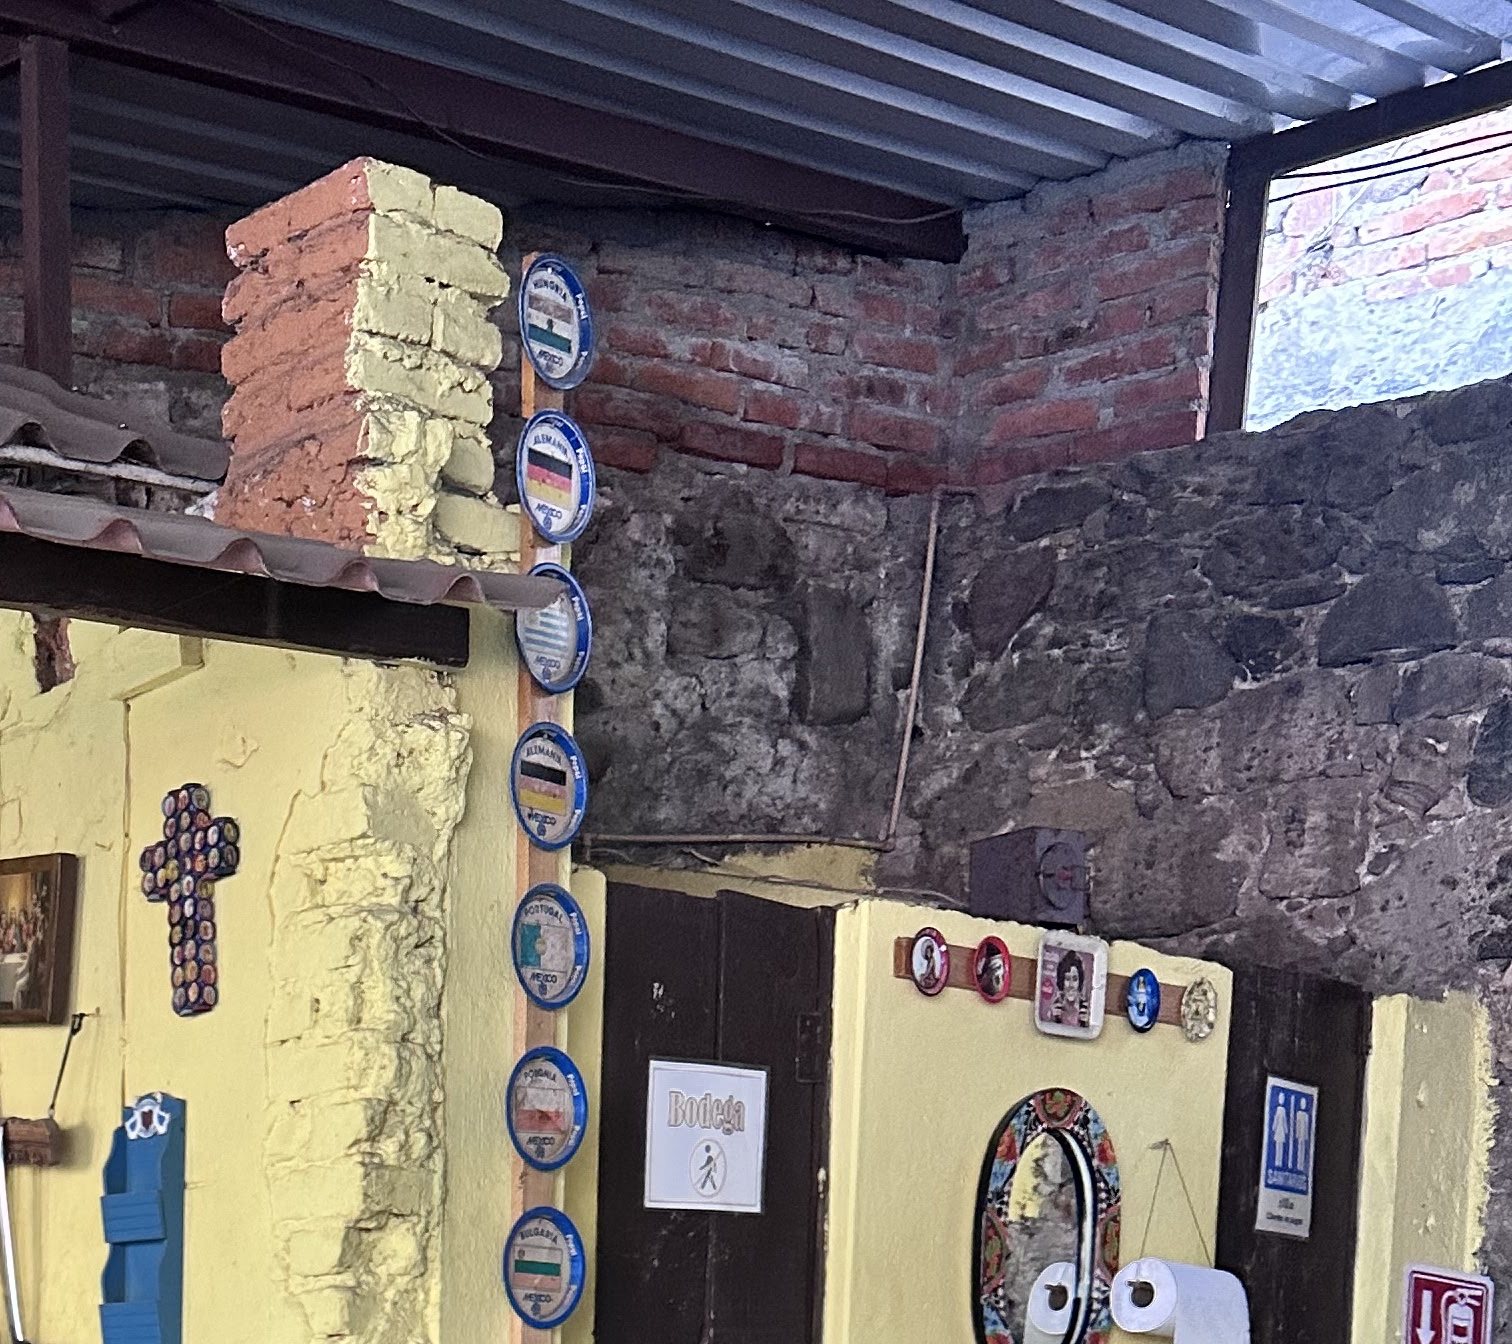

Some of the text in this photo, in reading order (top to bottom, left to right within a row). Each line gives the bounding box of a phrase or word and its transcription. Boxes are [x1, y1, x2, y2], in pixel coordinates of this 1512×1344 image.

[524, 904, 564, 924] PORTUGAL
[530, 972, 558, 984] MEXICO
[668, 1090, 746, 1136] Bodega
[519, 1227, 558, 1244] BULGARIA
